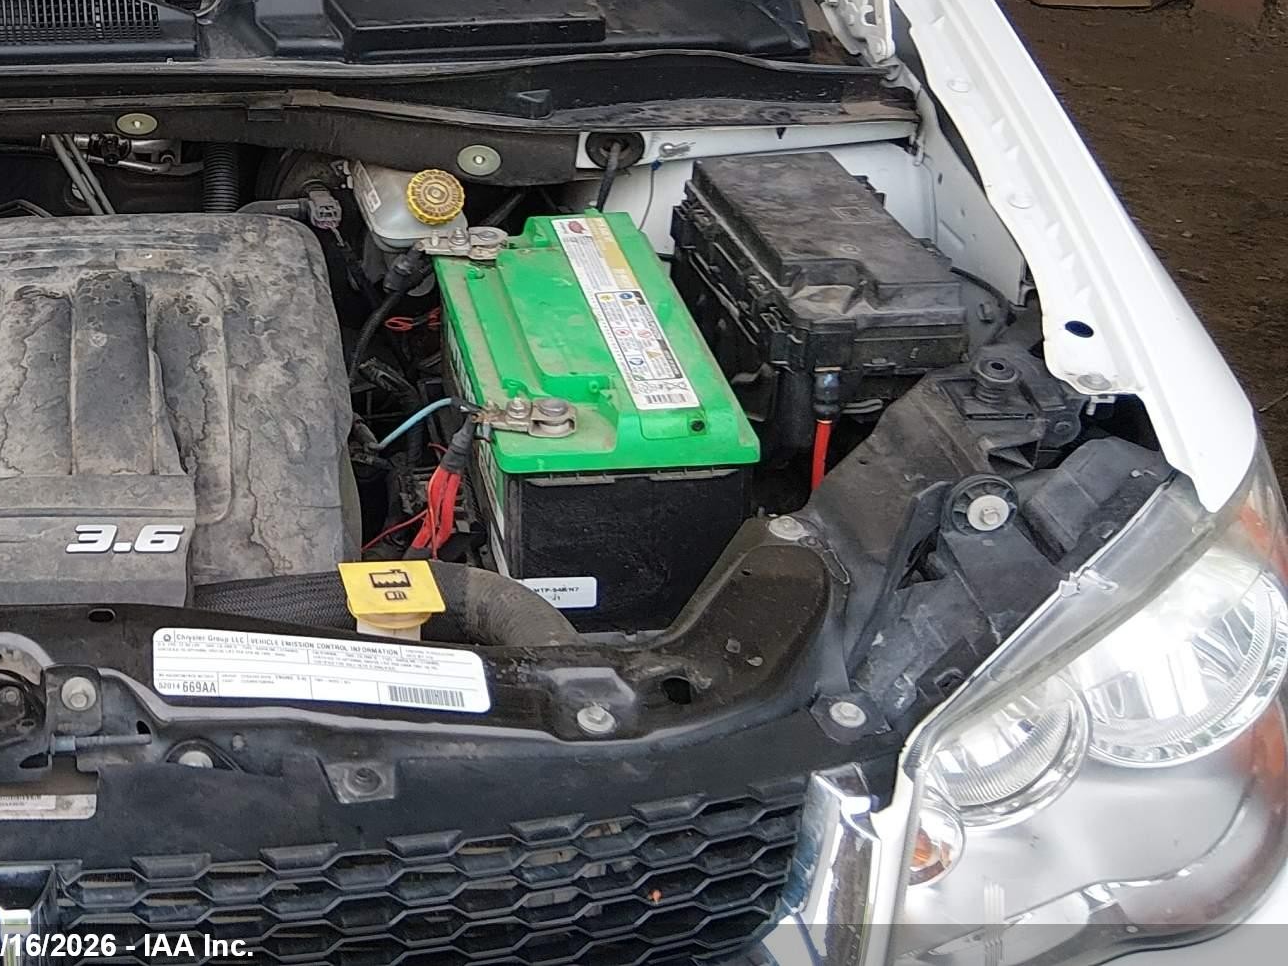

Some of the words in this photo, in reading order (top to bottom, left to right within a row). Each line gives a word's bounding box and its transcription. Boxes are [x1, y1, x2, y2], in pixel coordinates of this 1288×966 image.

[65, 524, 185, 553] 3.6
[176, 634, 205, 643] Chrysler
[207, 635, 229, 643] Group
[250, 638, 279, 646] VEHICLE
[281, 641, 314, 649] EMISSION
[316, 643, 348, 652] CONTROL
[350, 646, 399, 655] INFORMATION
[182, 681, 217, 693] 669AA
